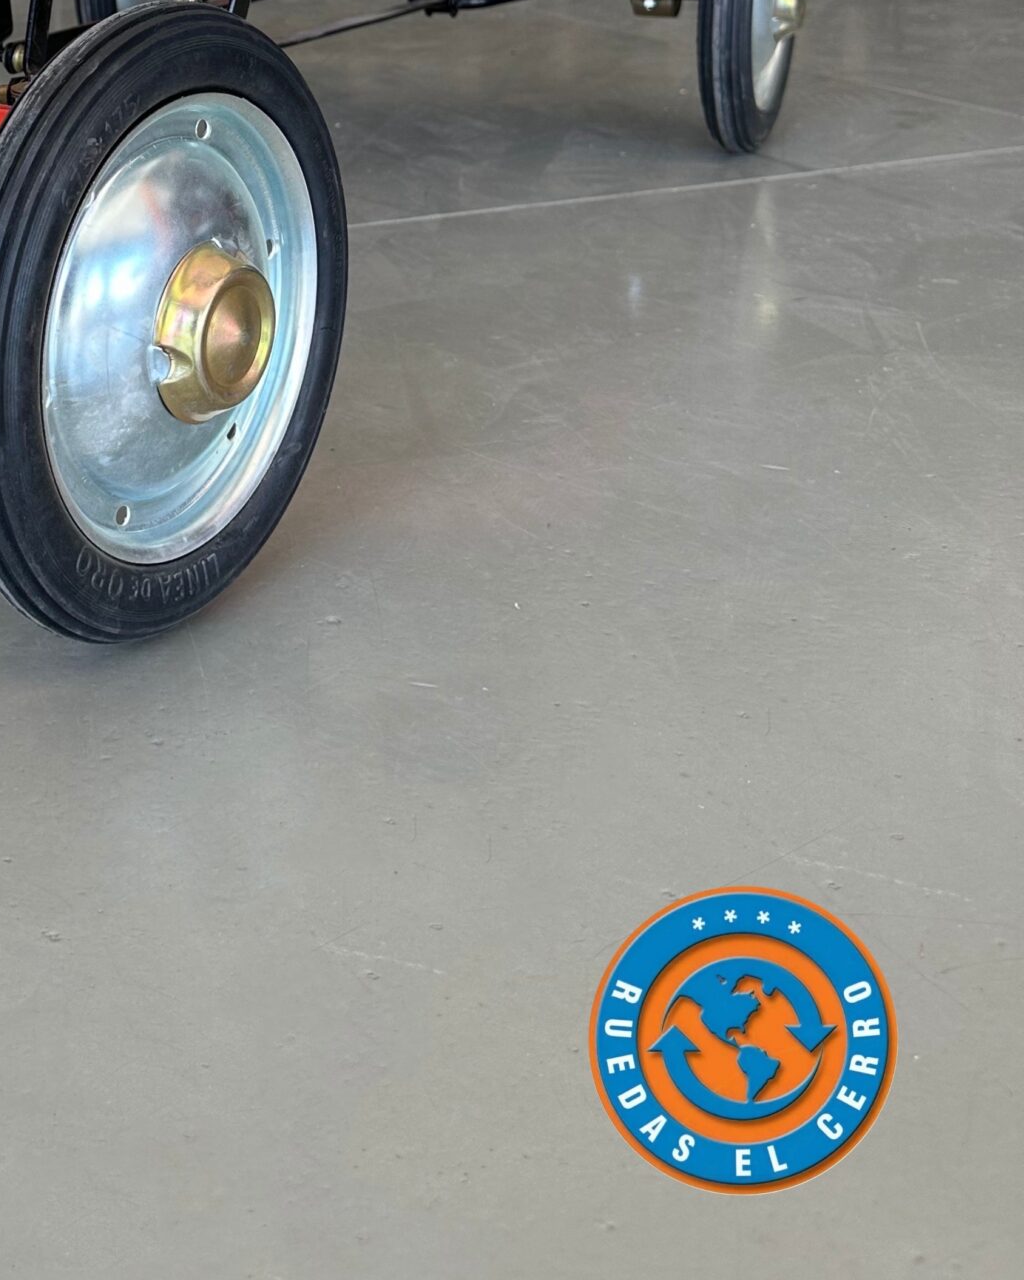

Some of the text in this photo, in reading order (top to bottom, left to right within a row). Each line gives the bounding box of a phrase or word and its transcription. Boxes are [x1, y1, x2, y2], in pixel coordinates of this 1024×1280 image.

[75, 544, 221, 605] LINEA DE ORO
